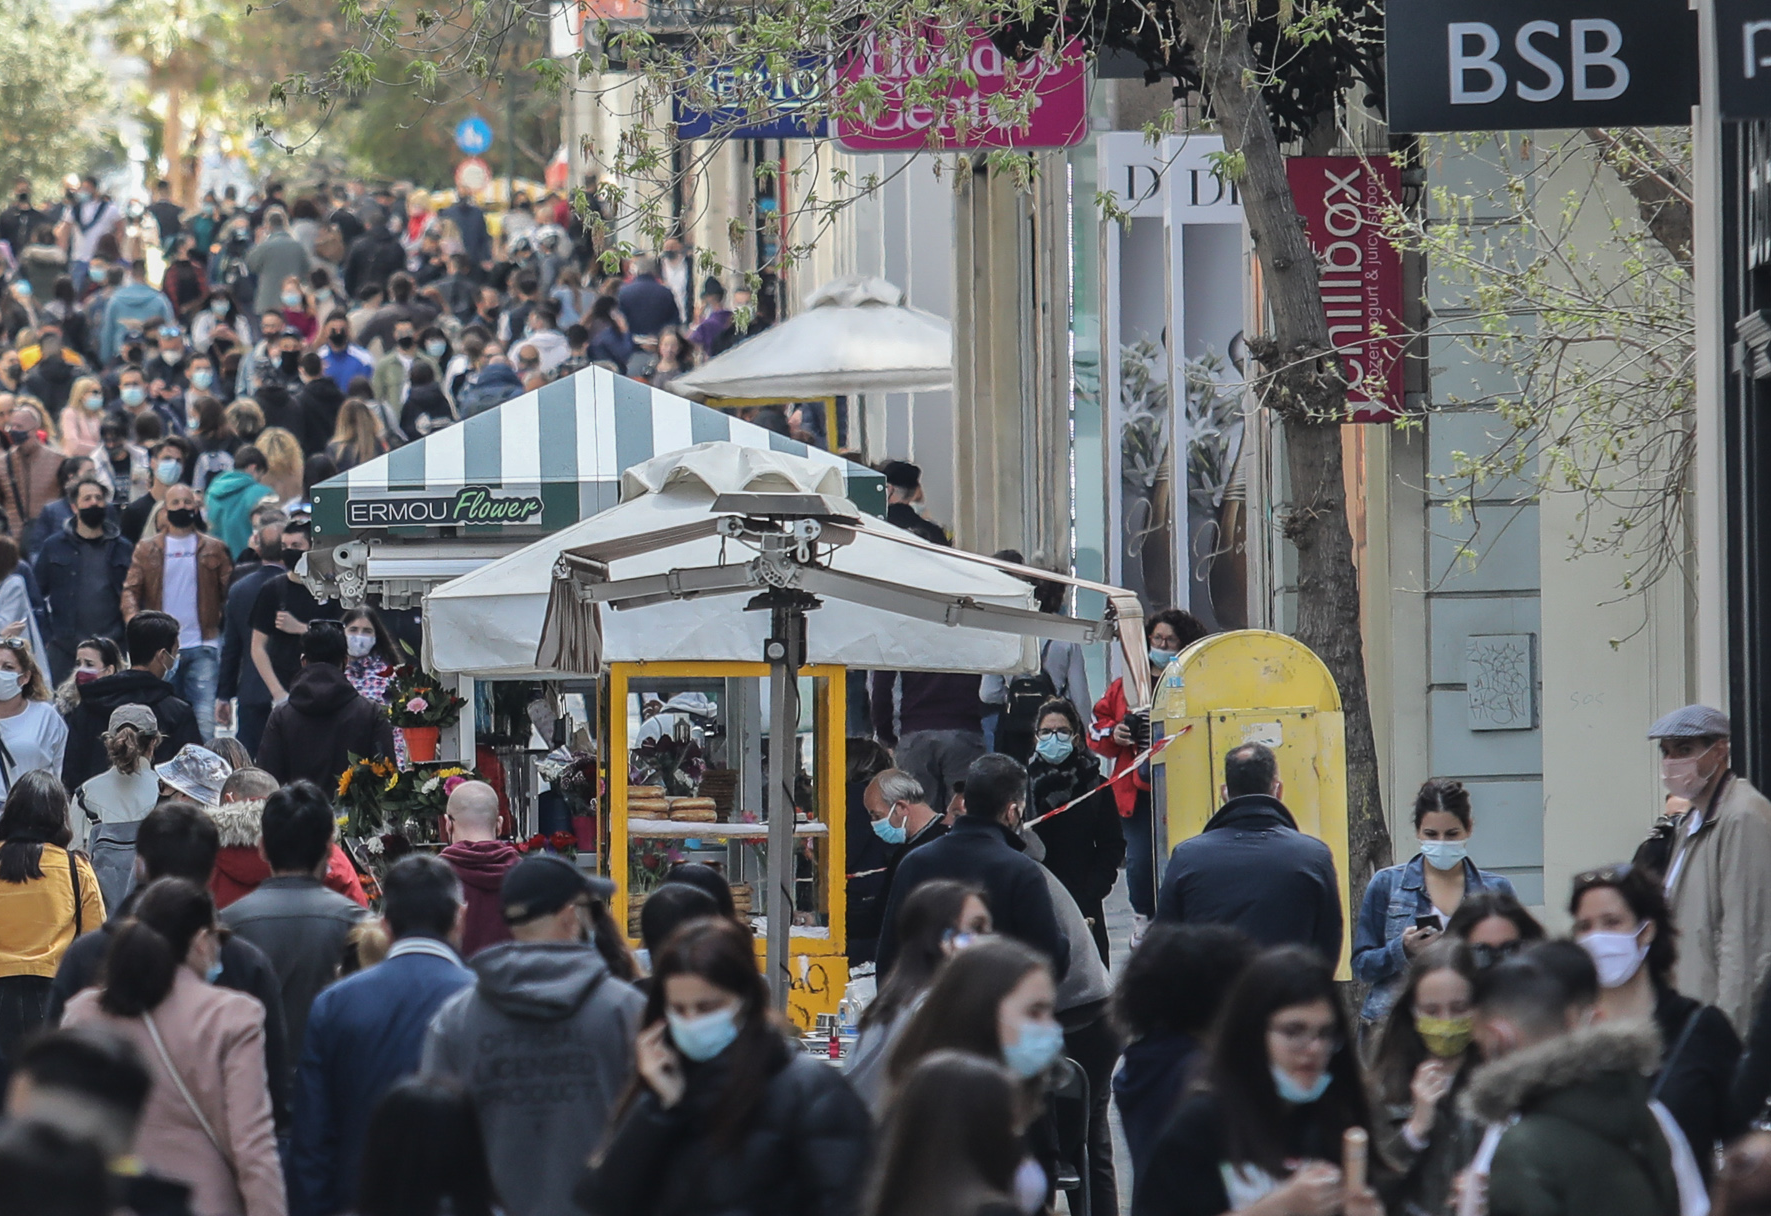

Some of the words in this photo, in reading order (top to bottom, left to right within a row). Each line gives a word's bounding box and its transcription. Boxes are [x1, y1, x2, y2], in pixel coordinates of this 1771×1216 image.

[1448, 18, 1630, 104] BSB
[858, 80, 1043, 131] Centr
[1318, 168, 1364, 390] chillbox
[351, 502, 447, 522] ERMOU
[453, 491, 539, 520] Flower
